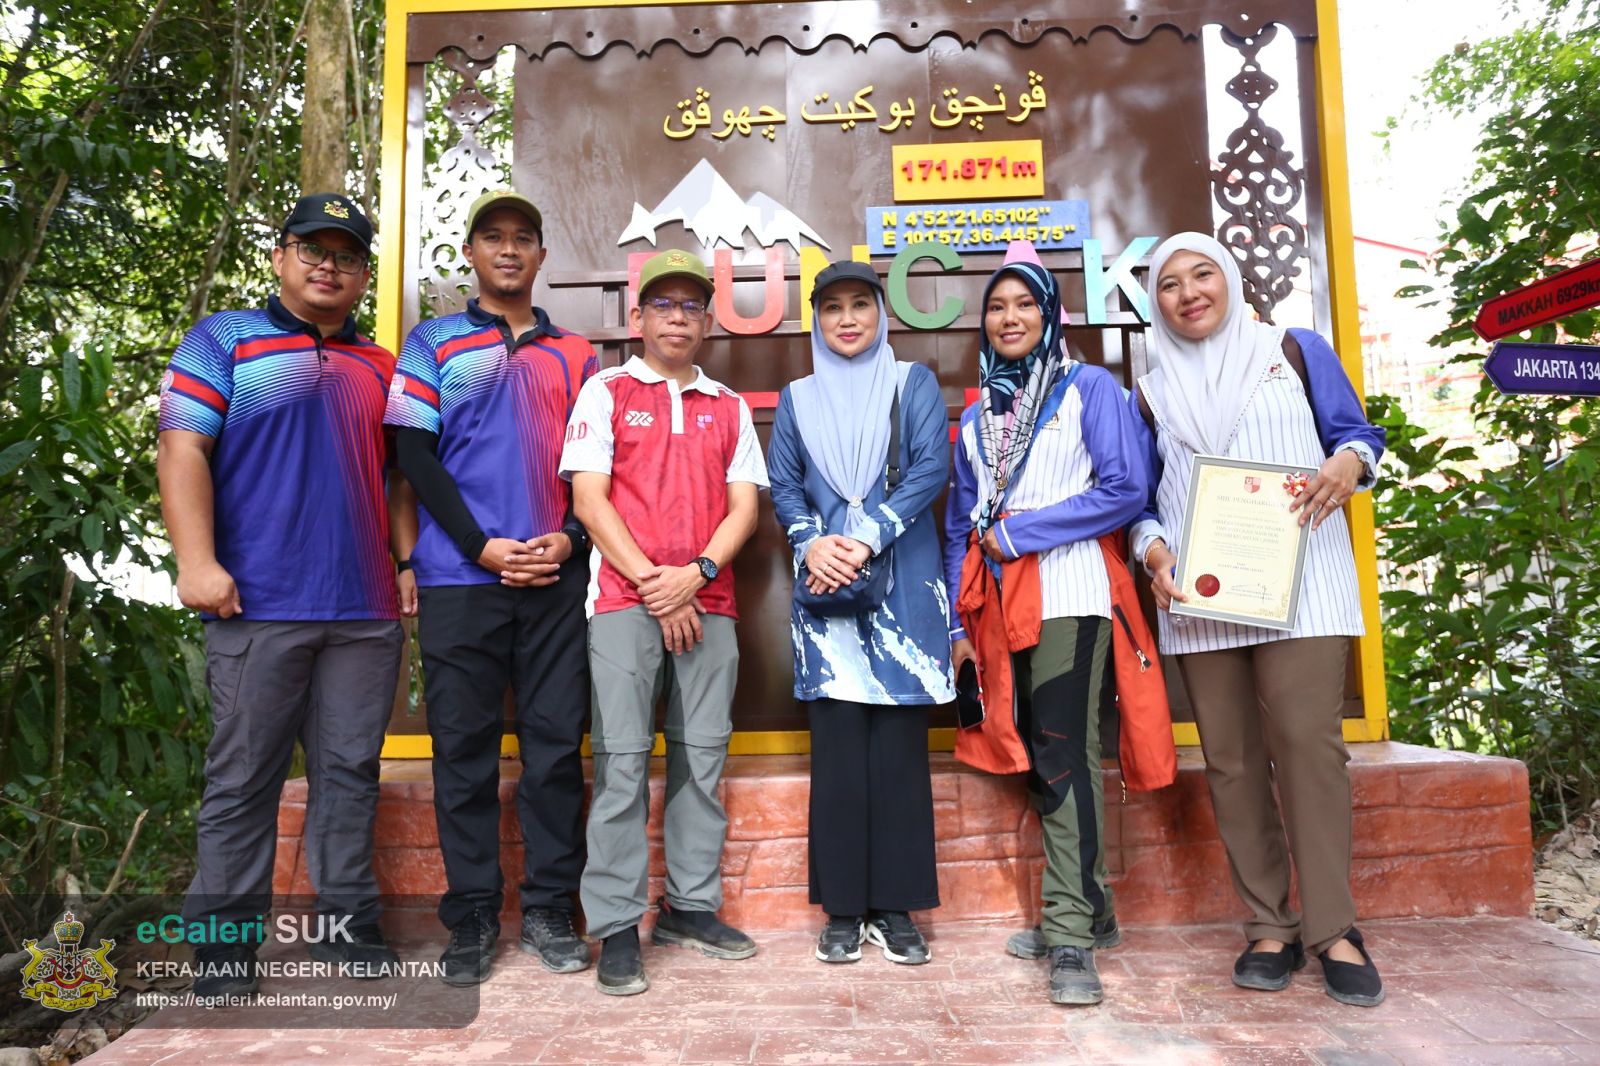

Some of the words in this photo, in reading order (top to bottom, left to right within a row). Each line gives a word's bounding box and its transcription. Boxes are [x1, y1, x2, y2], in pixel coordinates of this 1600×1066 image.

[901, 156, 1037, 181] 171.871m
[882, 211, 897, 227] N
[882, 230, 897, 246] E
[1497, 291, 1553, 325] MAKKAH
[1513, 358, 1577, 380] JAKARTA
